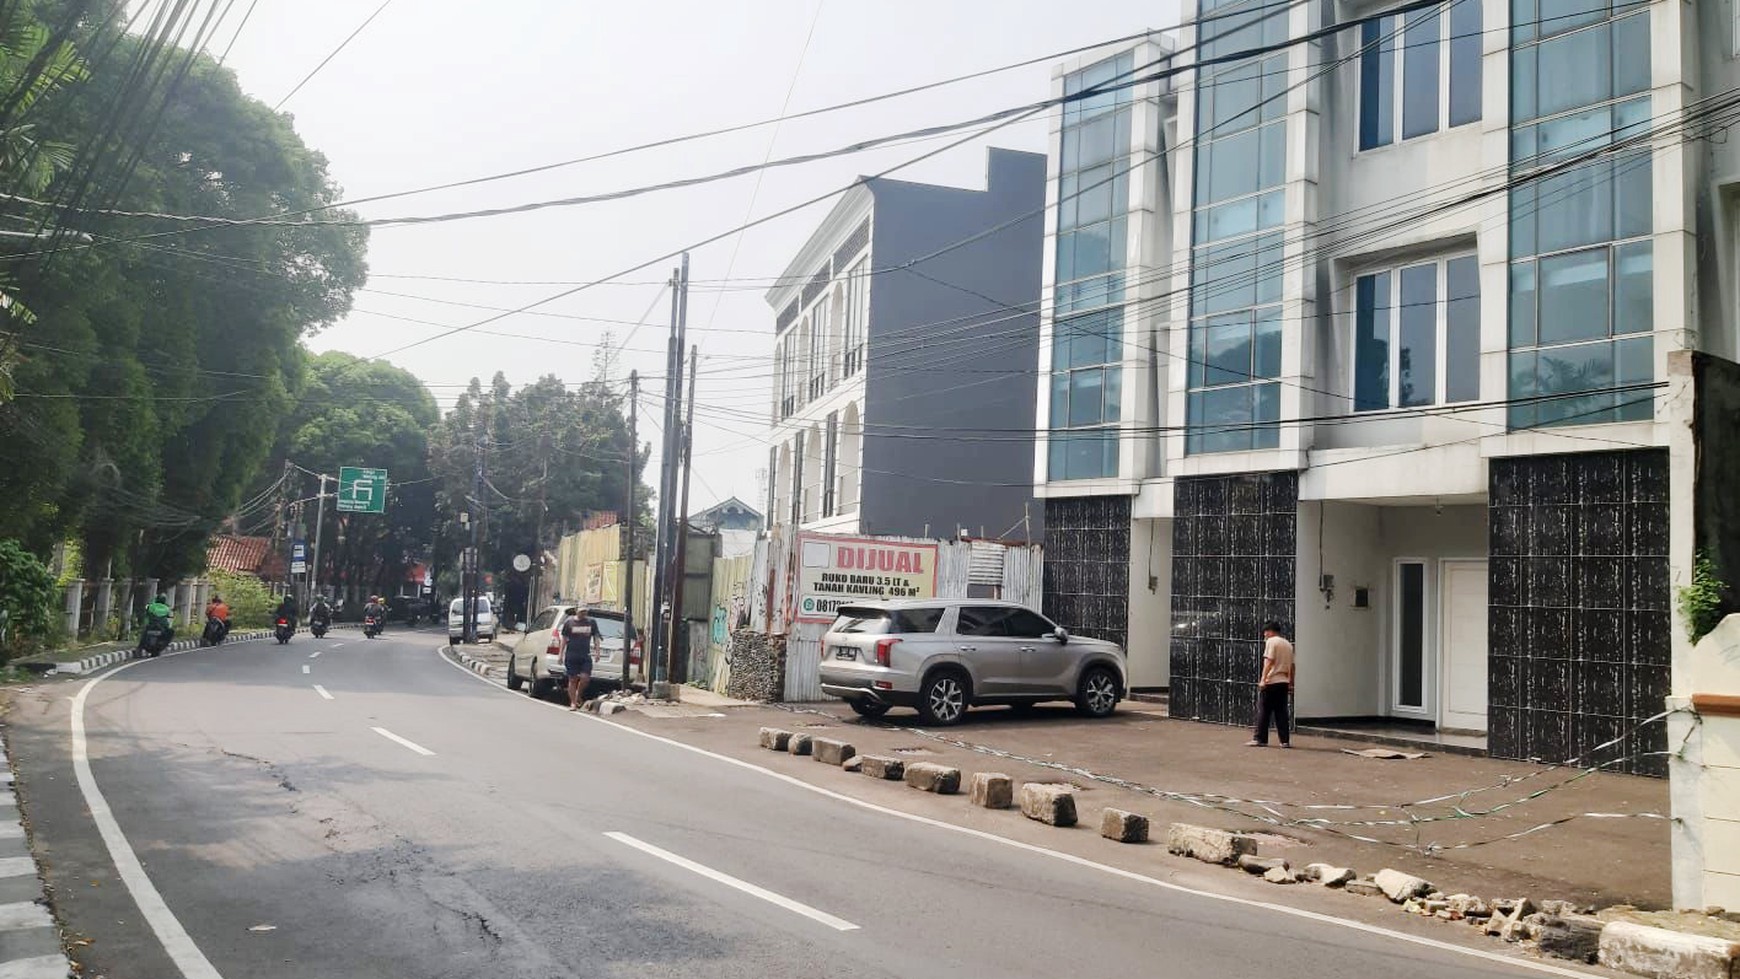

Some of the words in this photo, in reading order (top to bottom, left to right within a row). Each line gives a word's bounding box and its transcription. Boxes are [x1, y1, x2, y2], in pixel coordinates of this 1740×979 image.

[837, 546, 924, 574] DIJUAL
[822, 573, 847, 583] RUKO
[850, 575, 874, 585] BARU
[876, 577, 890, 586] 3.5
[893, 578, 901, 586] LT
[903, 579, 909, 587] &
[814, 582, 844, 592] TANAH
[846, 585, 884, 595] KAVLING
